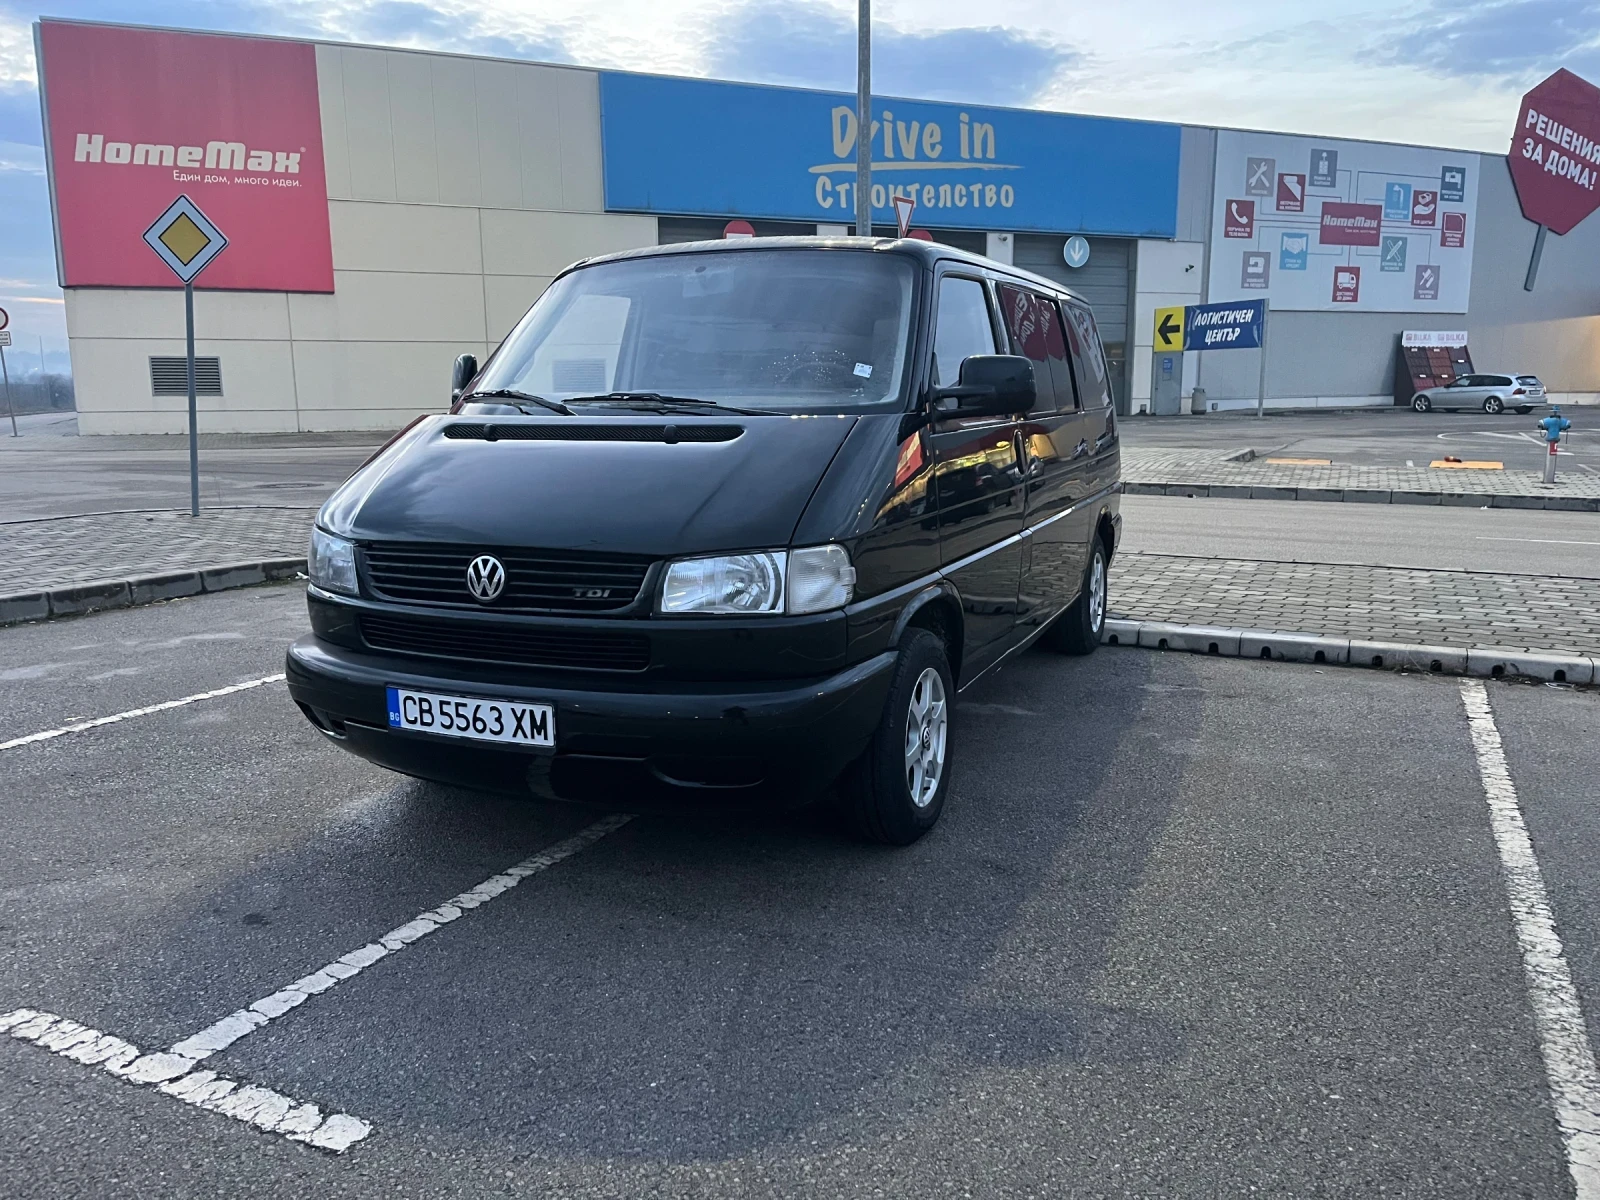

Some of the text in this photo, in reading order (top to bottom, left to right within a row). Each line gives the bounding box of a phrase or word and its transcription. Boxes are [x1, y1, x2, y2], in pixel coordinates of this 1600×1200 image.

[960, 113, 995, 159] in
[1525, 108, 1600, 165] РЕШЕНИЯ
[74, 133, 301, 173] HomeMax
[1522, 137, 1597, 191] ЗА ДОМА!
[173, 170, 302, 188] Един дом, много идеи.
[1322, 214, 1378, 228] HomeMax
[1194, 308, 1254, 326] ЛОГИСТИЧЕН
[1204, 327, 1240, 346] ЦЕНТЪР
[572, 587, 612, 598] TDI
[389, 711, 400, 722] BG
